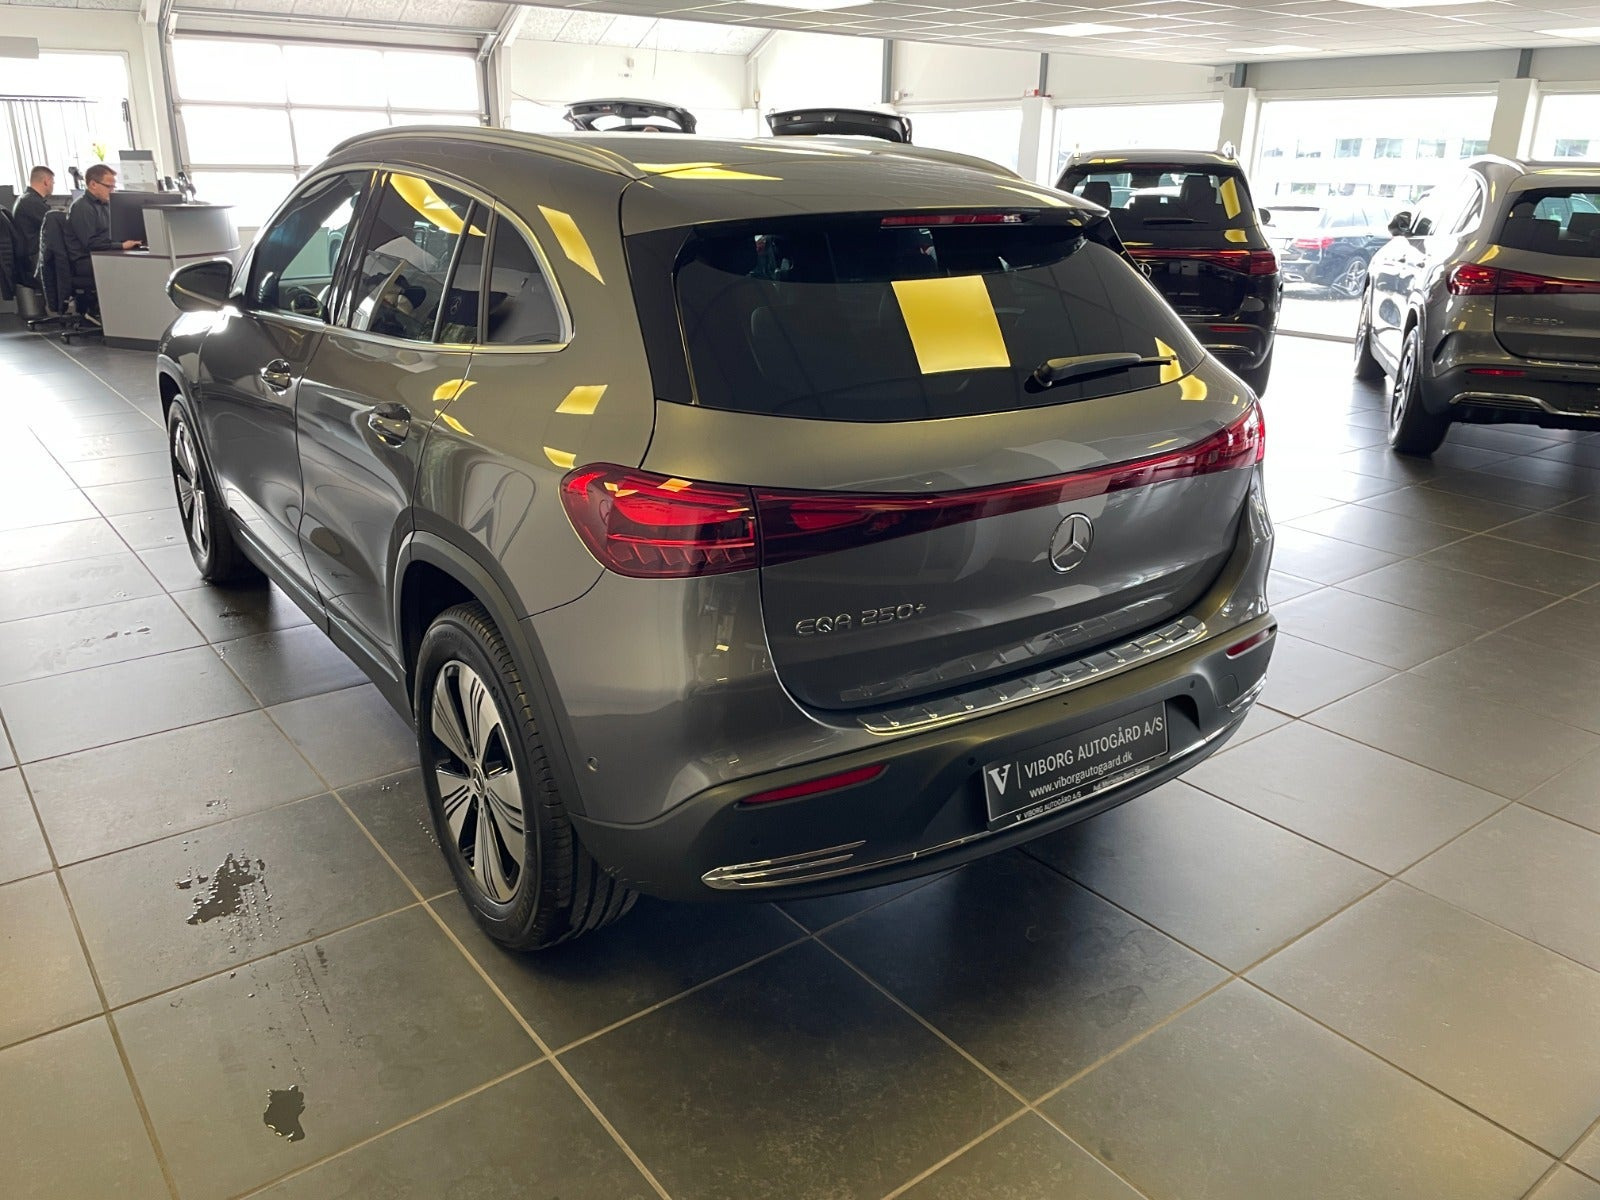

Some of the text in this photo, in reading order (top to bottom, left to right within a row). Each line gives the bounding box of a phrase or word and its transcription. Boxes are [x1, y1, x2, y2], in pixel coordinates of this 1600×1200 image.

[796, 603, 927, 635] EQA 250+
[1024, 749, 1074, 779] VIBORG
[1078, 726, 1141, 760] AUTOGÅRD
[1144, 716, 1164, 737] A/S
[1029, 751, 1133, 798] www.viborgautogaard.dk
[1023, 803, 1044, 819] VIBORG
